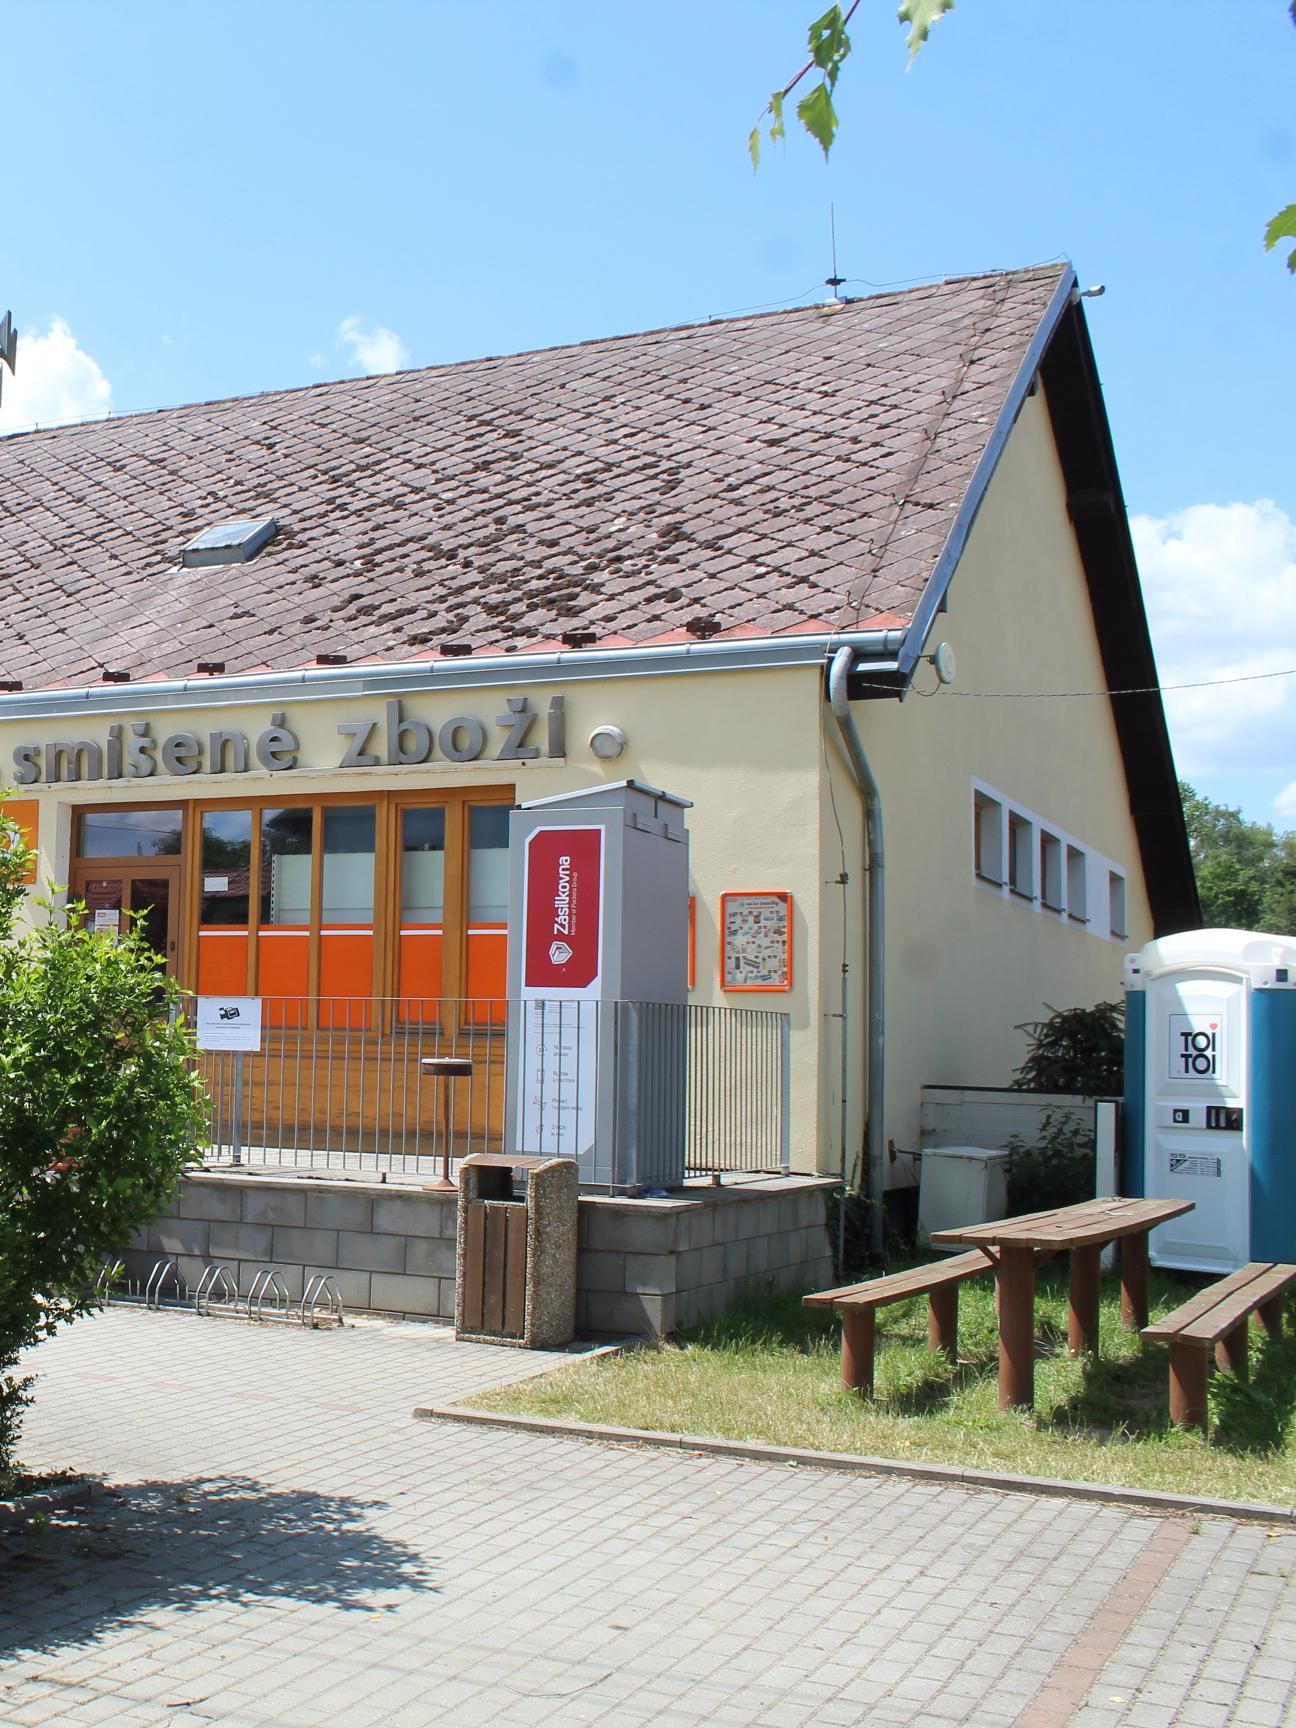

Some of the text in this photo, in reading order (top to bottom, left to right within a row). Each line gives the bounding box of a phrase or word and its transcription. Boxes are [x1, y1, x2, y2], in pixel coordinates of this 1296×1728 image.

[13, 694, 566, 785] smíšené zboží
[554, 856, 570, 935] Zásilkovna
[1180, 1031, 1216, 1053] TOI
[1180, 1053, 1216, 1075] TOI
